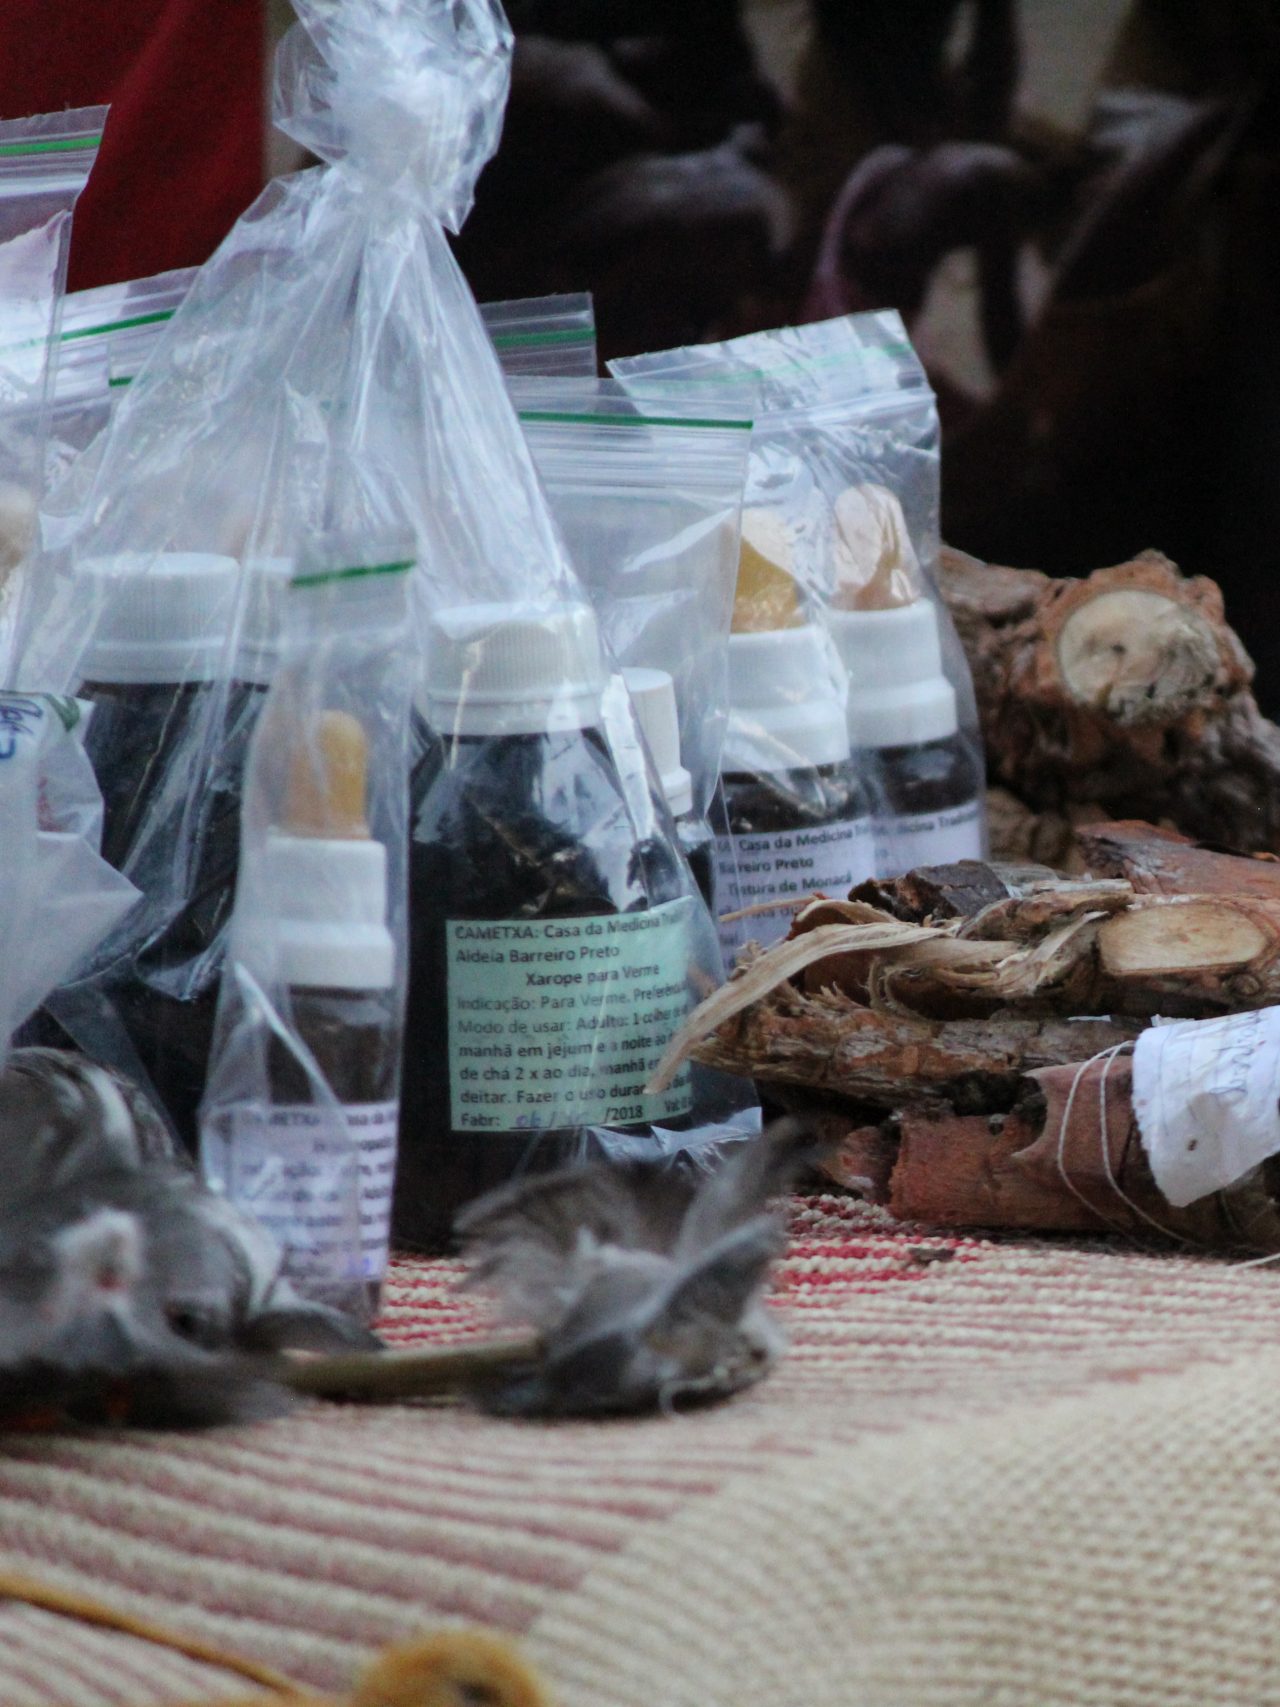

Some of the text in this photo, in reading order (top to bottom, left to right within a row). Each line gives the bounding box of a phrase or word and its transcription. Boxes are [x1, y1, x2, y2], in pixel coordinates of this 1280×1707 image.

[739, 839, 770, 851] Casa
[774, 836, 792, 849] da
[796, 829, 853, 847] Medicina
[776, 857, 814, 871] Preto
[779, 879, 797, 892] de
[544, 924, 580, 938] Casa
[585, 921, 602, 935] da
[607, 917, 660, 933] Medicina
[456, 945, 620, 963] Aldeia Barreiro Preto
[526, 964, 660, 987] Xarope para Verme
[457, 996, 536, 1013] Indicação:
[541, 995, 574, 1009] Para
[458, 1019, 504, 1034] Modo
[508, 1019, 527, 1033] de
[459, 1044, 512, 1058] manhã
[517, 1046, 543, 1057] em
[547, 1042, 592, 1060] jejum
[621, 1035, 651, 1050] noite
[459, 1067, 478, 1080] de
[483, 1065, 510, 1081] chá
[515, 1067, 524, 1080] 2
[530, 1070, 538, 1080] x
[543, 1068, 563, 1079] ao
[460, 1090, 512, 1104] deitar.
[516, 1090, 557, 1104] Fazer
[461, 1112, 500, 1127] Fabr:
